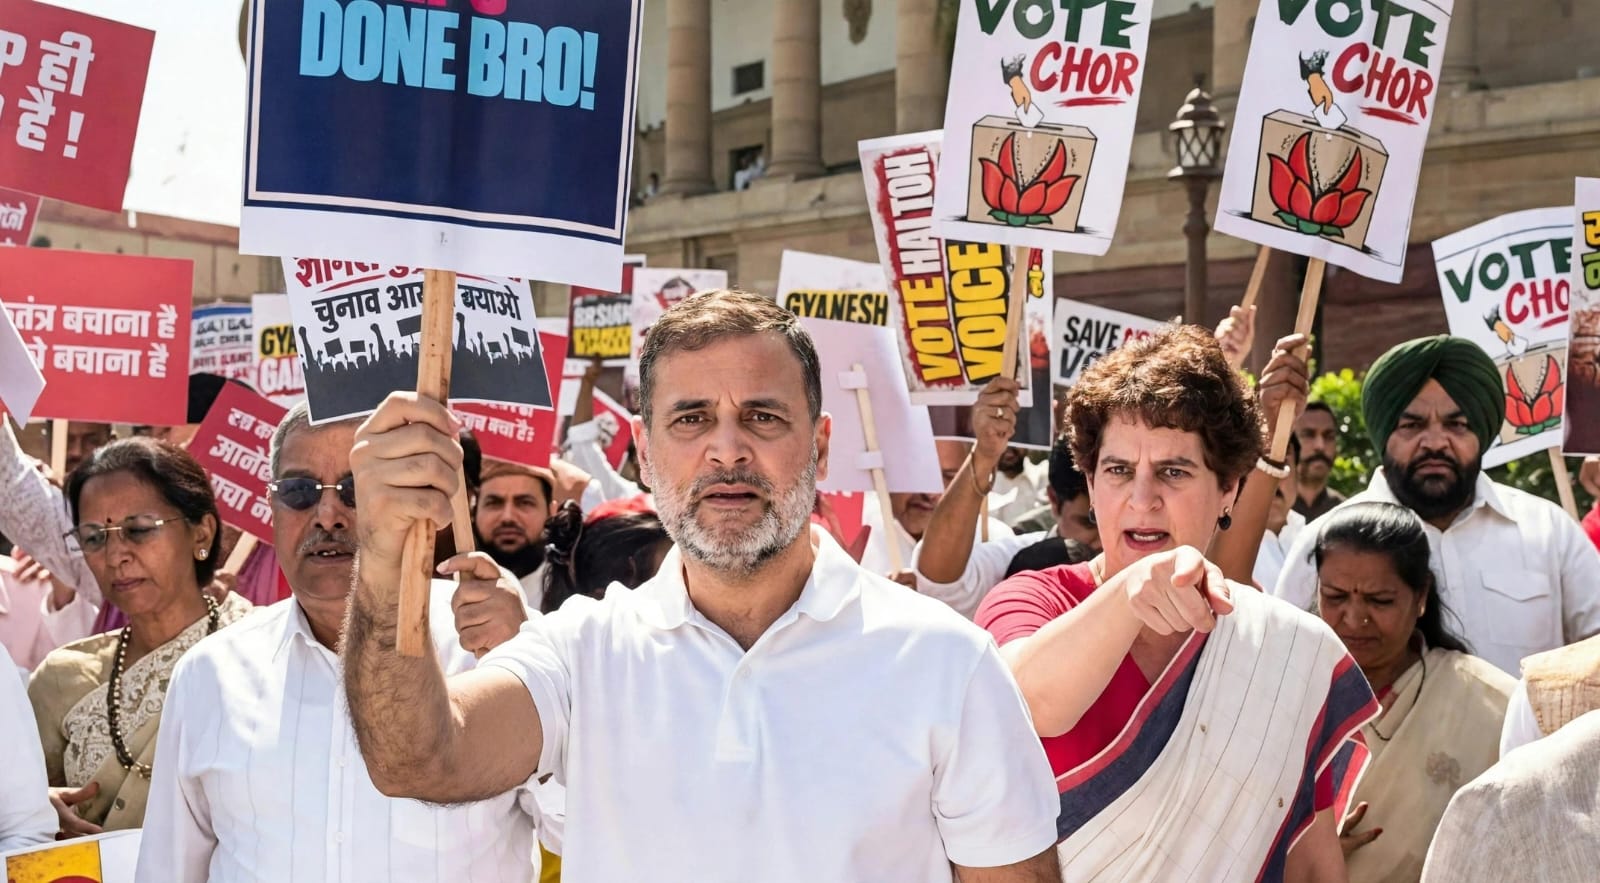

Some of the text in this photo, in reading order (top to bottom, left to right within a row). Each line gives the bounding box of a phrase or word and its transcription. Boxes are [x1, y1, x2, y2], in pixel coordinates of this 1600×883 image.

[972, 0, 1141, 49] VOTE
[1276, 0, 1439, 69] VOTE
[37, 31, 95, 97] ही
[299, 0, 599, 111] DONE BRO!
[1029, 41, 1139, 97] CHOR
[1332, 42, 1434, 119] CHOR
[884, 152, 933, 217] TOH
[1444, 237, 1574, 304] VOTE
[62, 305, 151, 338] बचाना
[157, 303, 178, 339] है
[311, 288, 381, 333] चुनाव
[785, 292, 889, 327] GYANESH
[900, 276, 962, 382] VOTE
[947, 243, 1007, 381] VOICE
[1505, 278, 1571, 325] CHO
[53, 344, 141, 377] बचाना
[148, 343, 169, 378] है
[261, 326, 298, 355] GYA
[1063, 316, 1122, 351] SAVE
